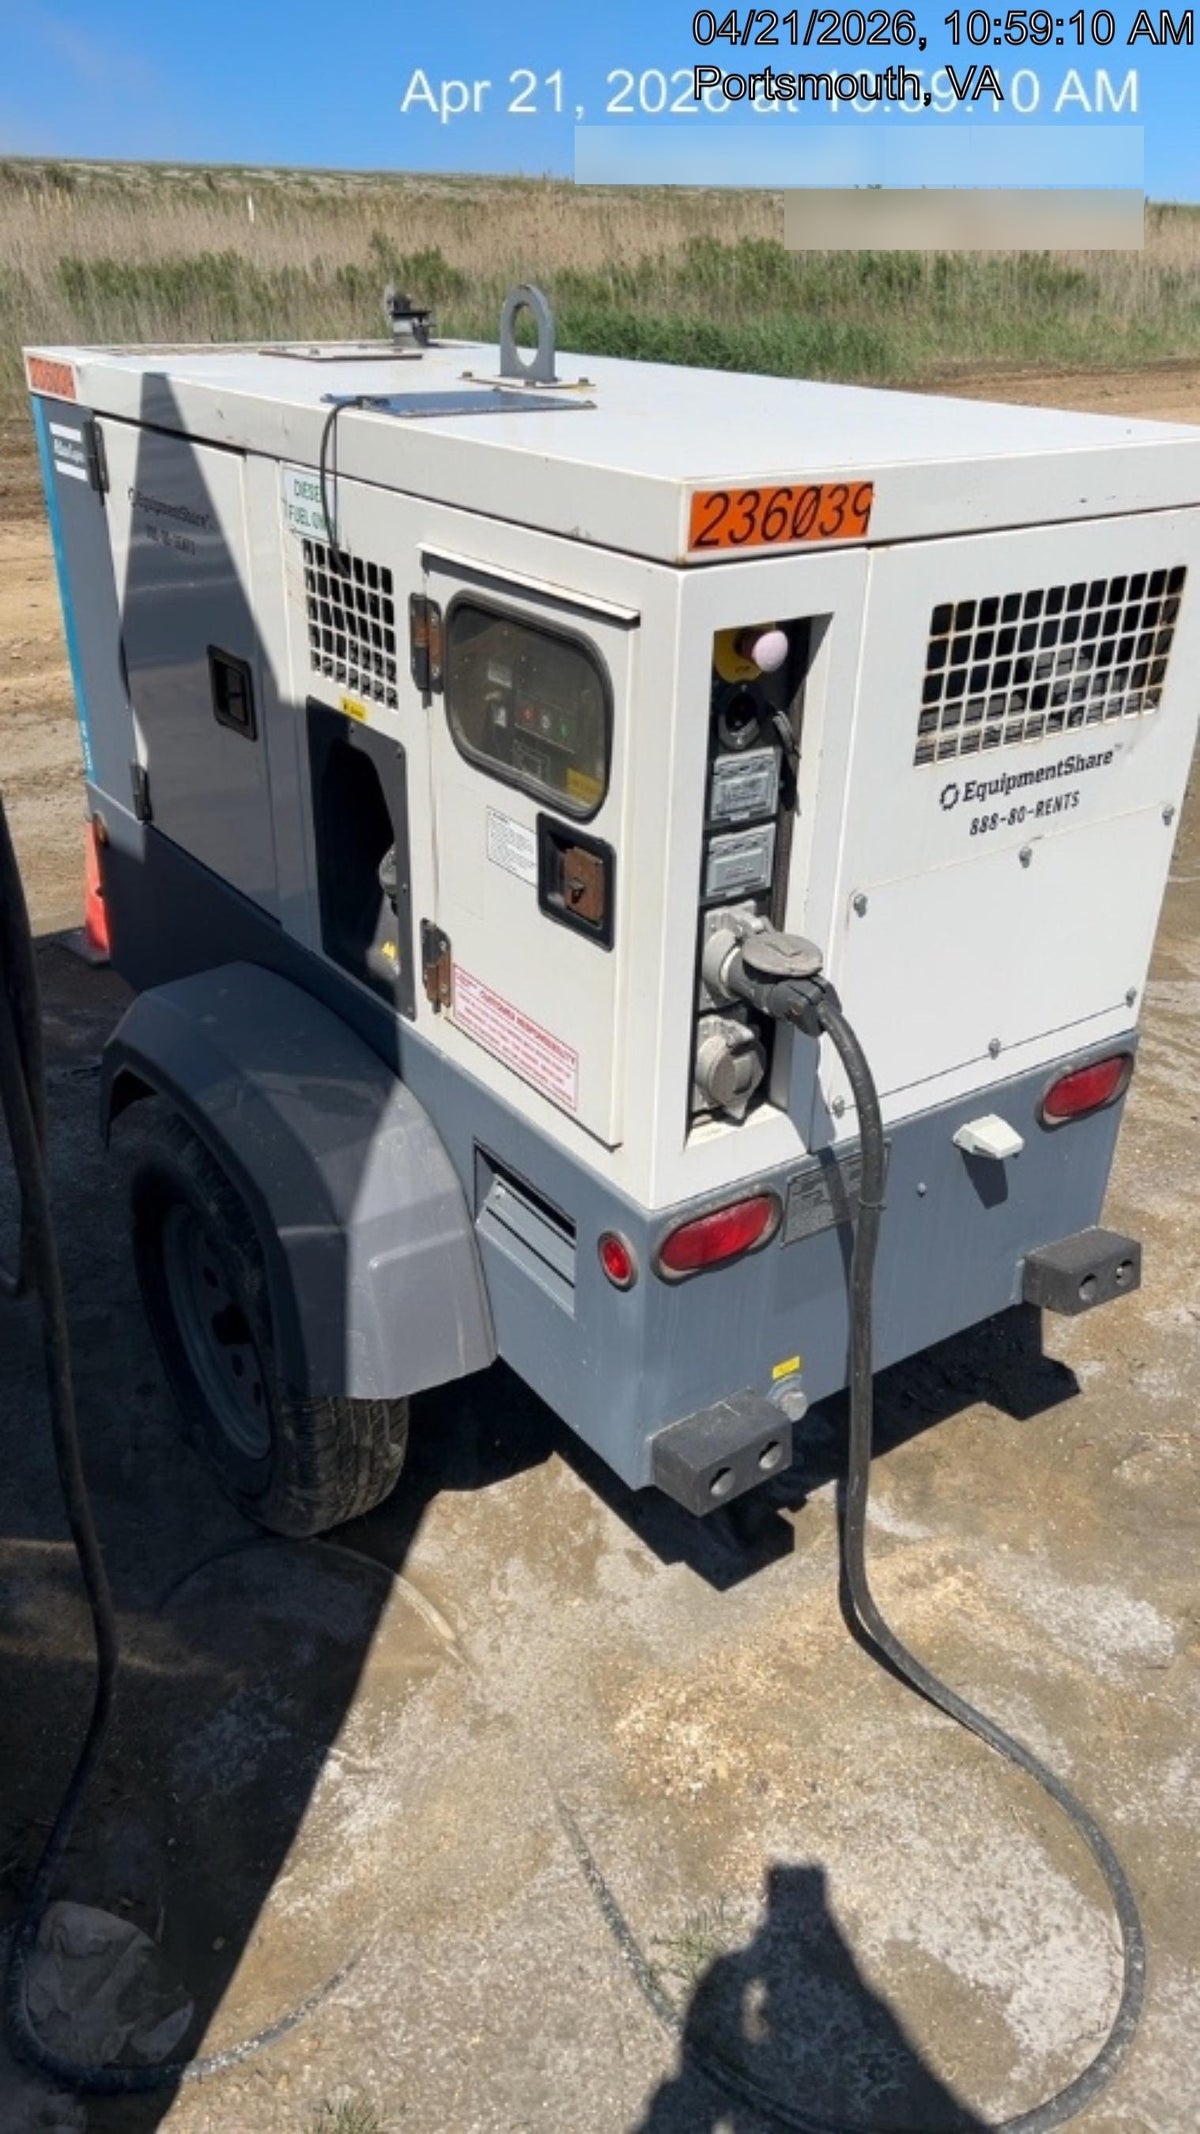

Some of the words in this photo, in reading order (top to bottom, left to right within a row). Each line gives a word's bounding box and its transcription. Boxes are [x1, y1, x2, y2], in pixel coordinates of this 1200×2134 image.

[693, 481, 873, 548] 236039
[962, 749, 1114, 803] EquipmentShare
[970, 790, 1080, 836] 888-80-RENTS
